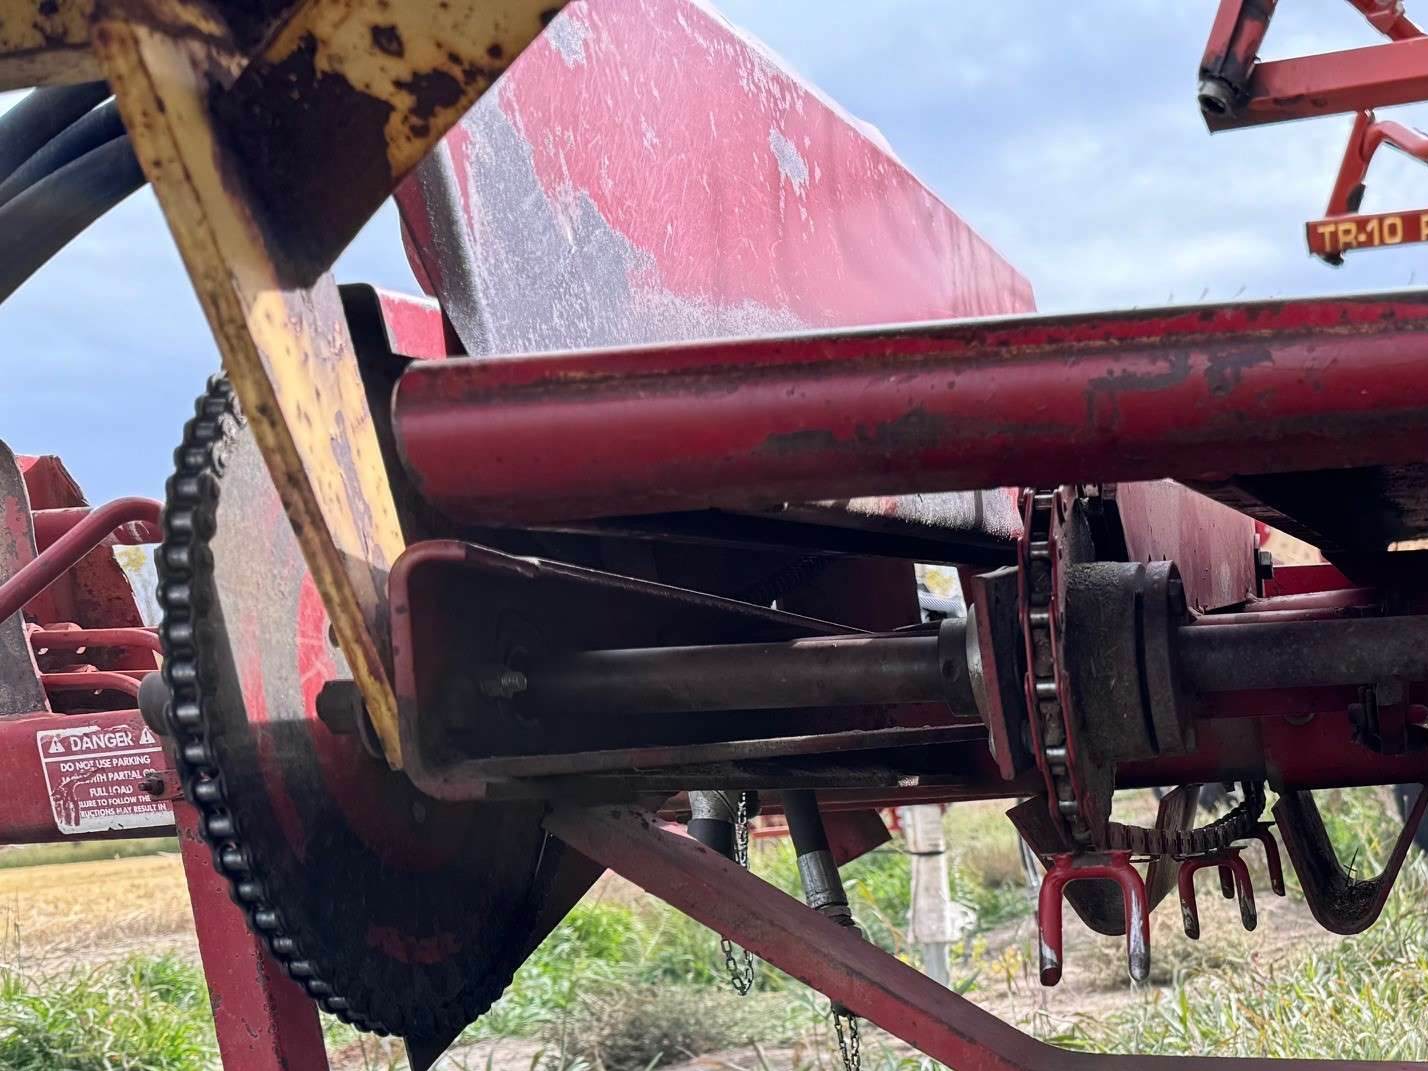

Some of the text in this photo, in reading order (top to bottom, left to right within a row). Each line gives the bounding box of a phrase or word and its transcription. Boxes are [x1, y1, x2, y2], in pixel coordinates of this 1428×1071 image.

[1316, 216, 1403, 252] TR-10
[70, 732, 134, 751] DANGER
[60, 755, 151, 771] DO NOT USE PARKING
[108, 770, 143, 782] PARTIAL
[90, 784, 133, 798] FULL LOAD
[97, 798, 108, 807] TO
[108, 795, 137, 806] FOLLOW
[116, 806, 132, 815] MAY
[133, 804, 157, 813] RESULT
[157, 802, 167, 811] IN
